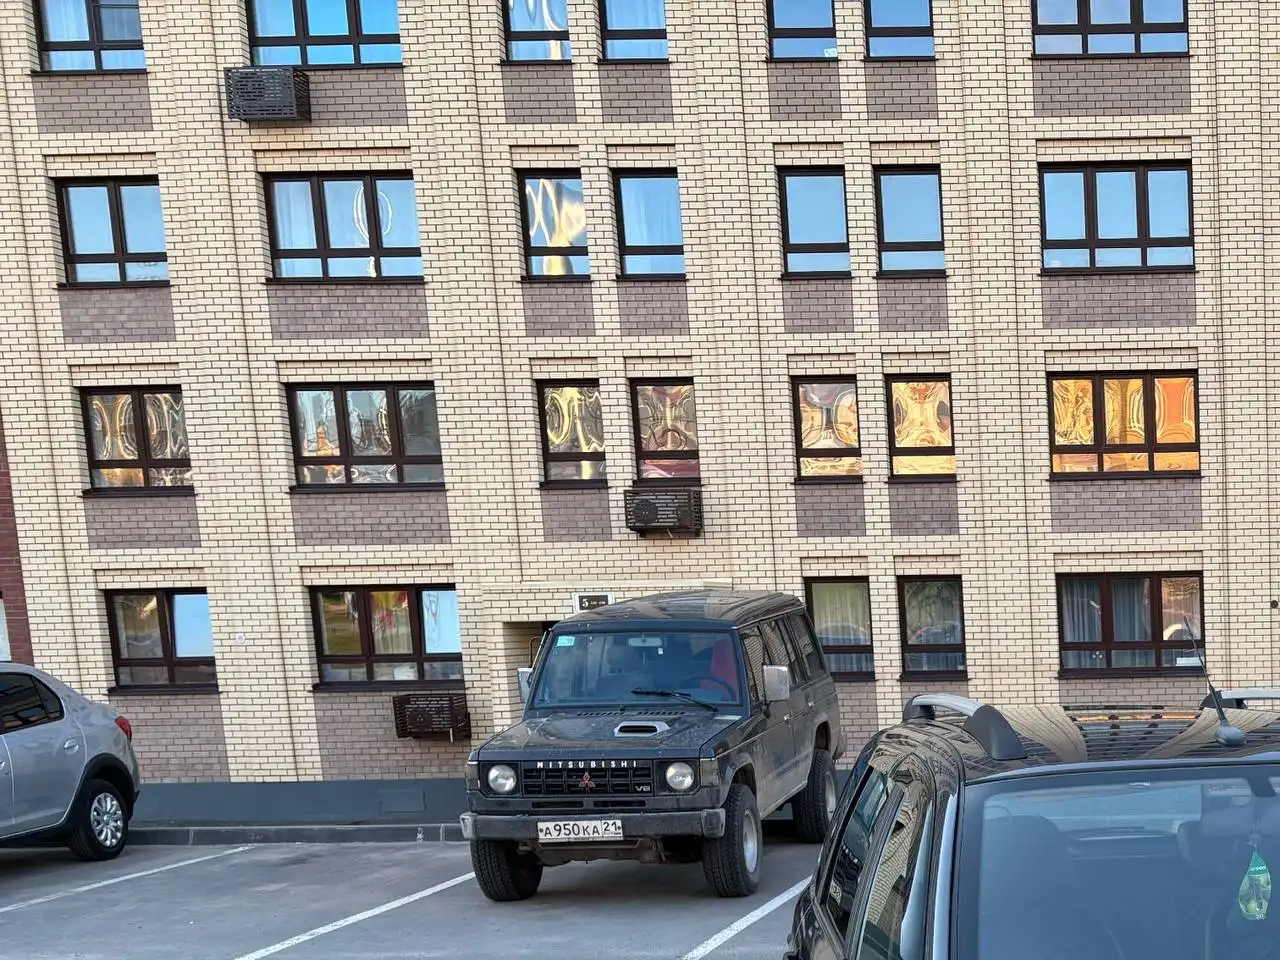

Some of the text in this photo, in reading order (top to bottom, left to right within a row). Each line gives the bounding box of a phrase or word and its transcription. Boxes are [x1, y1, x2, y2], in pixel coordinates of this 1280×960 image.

[582, 599, 589, 607] 5
[537, 760, 637, 769] MITSUBISHI
[603, 821, 618, 832] 21
